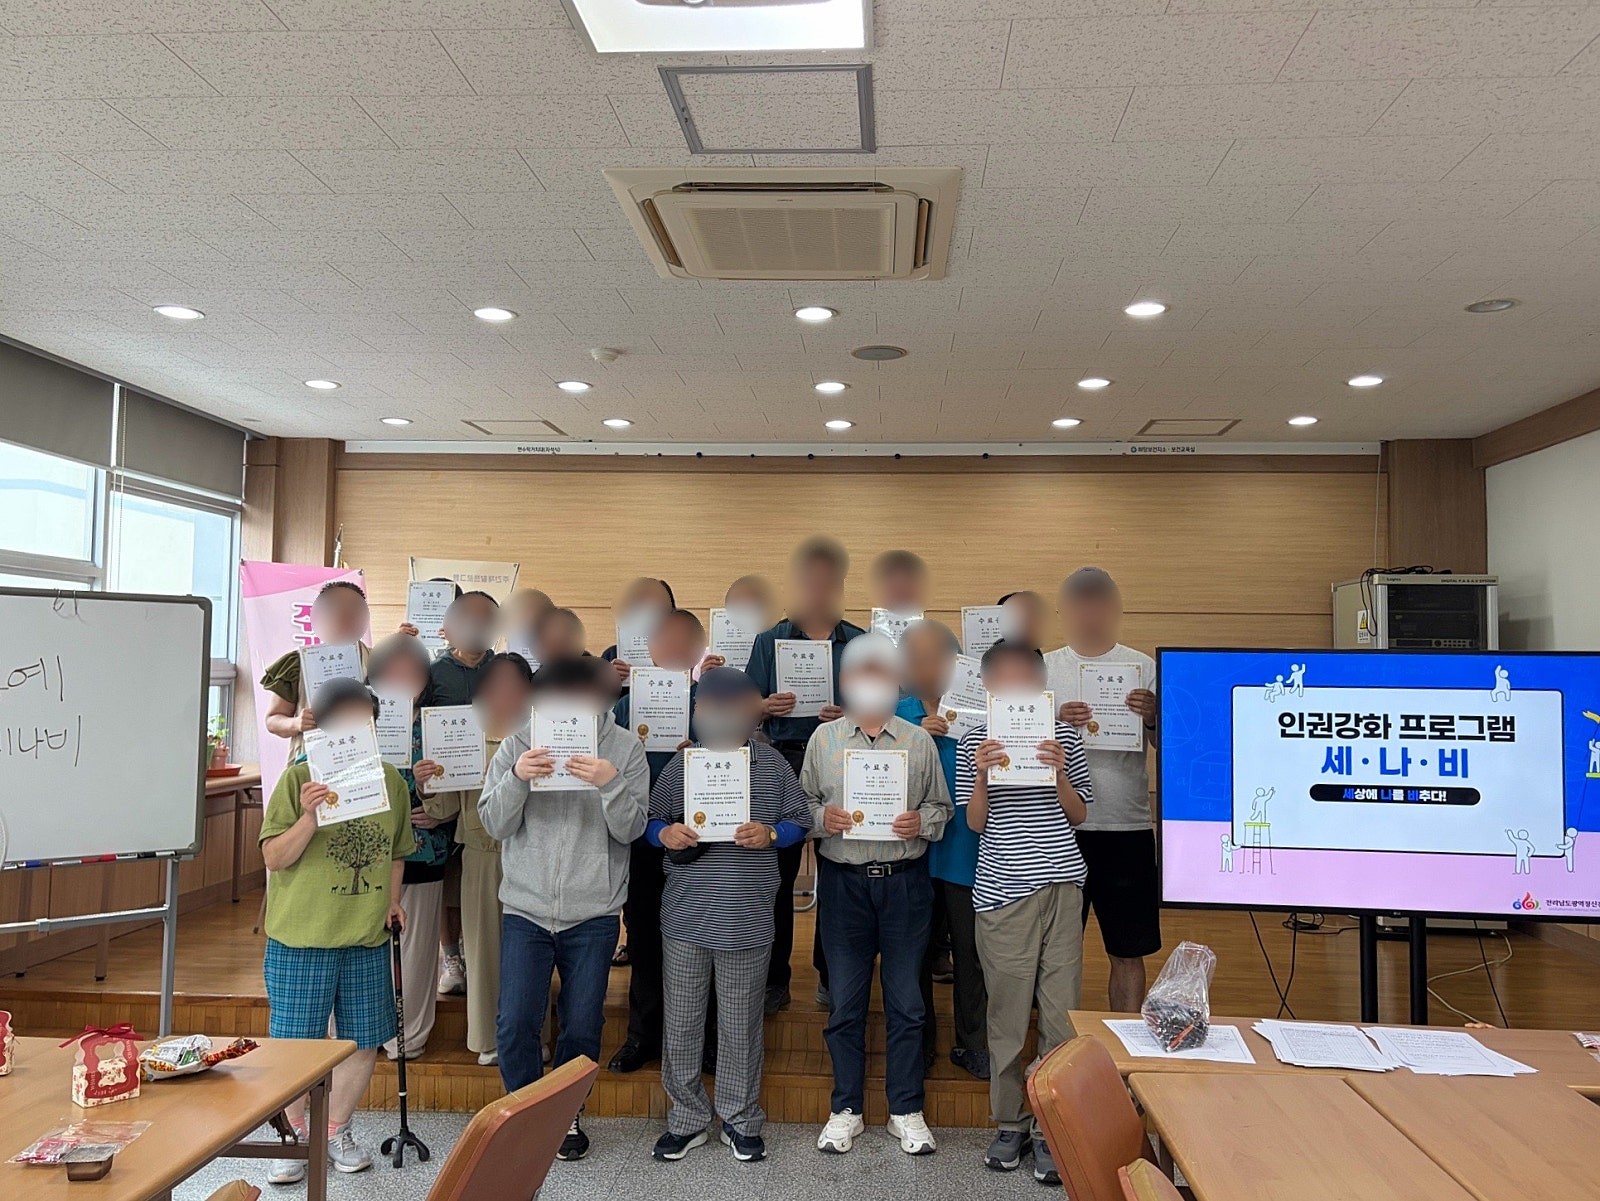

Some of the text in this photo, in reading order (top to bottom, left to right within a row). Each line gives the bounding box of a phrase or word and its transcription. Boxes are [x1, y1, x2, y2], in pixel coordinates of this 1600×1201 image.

[319, 653, 345, 662] 수료증
[791, 652, 816, 660] 수료증
[648, 679, 674, 688] 수료증
[1096, 675, 1125, 684] 수료증
[1007, 704, 1037, 713] 수료증
[440, 718, 468, 727] 수료증
[1278, 712, 1516, 743] 인권강화 프로그램
[327, 736, 358, 749] 수료증
[704, 761, 732, 771] 수료증
[863, 763, 890, 772] 수료증
[1343, 788, 1447, 802] 세상에 나를 비추다!
